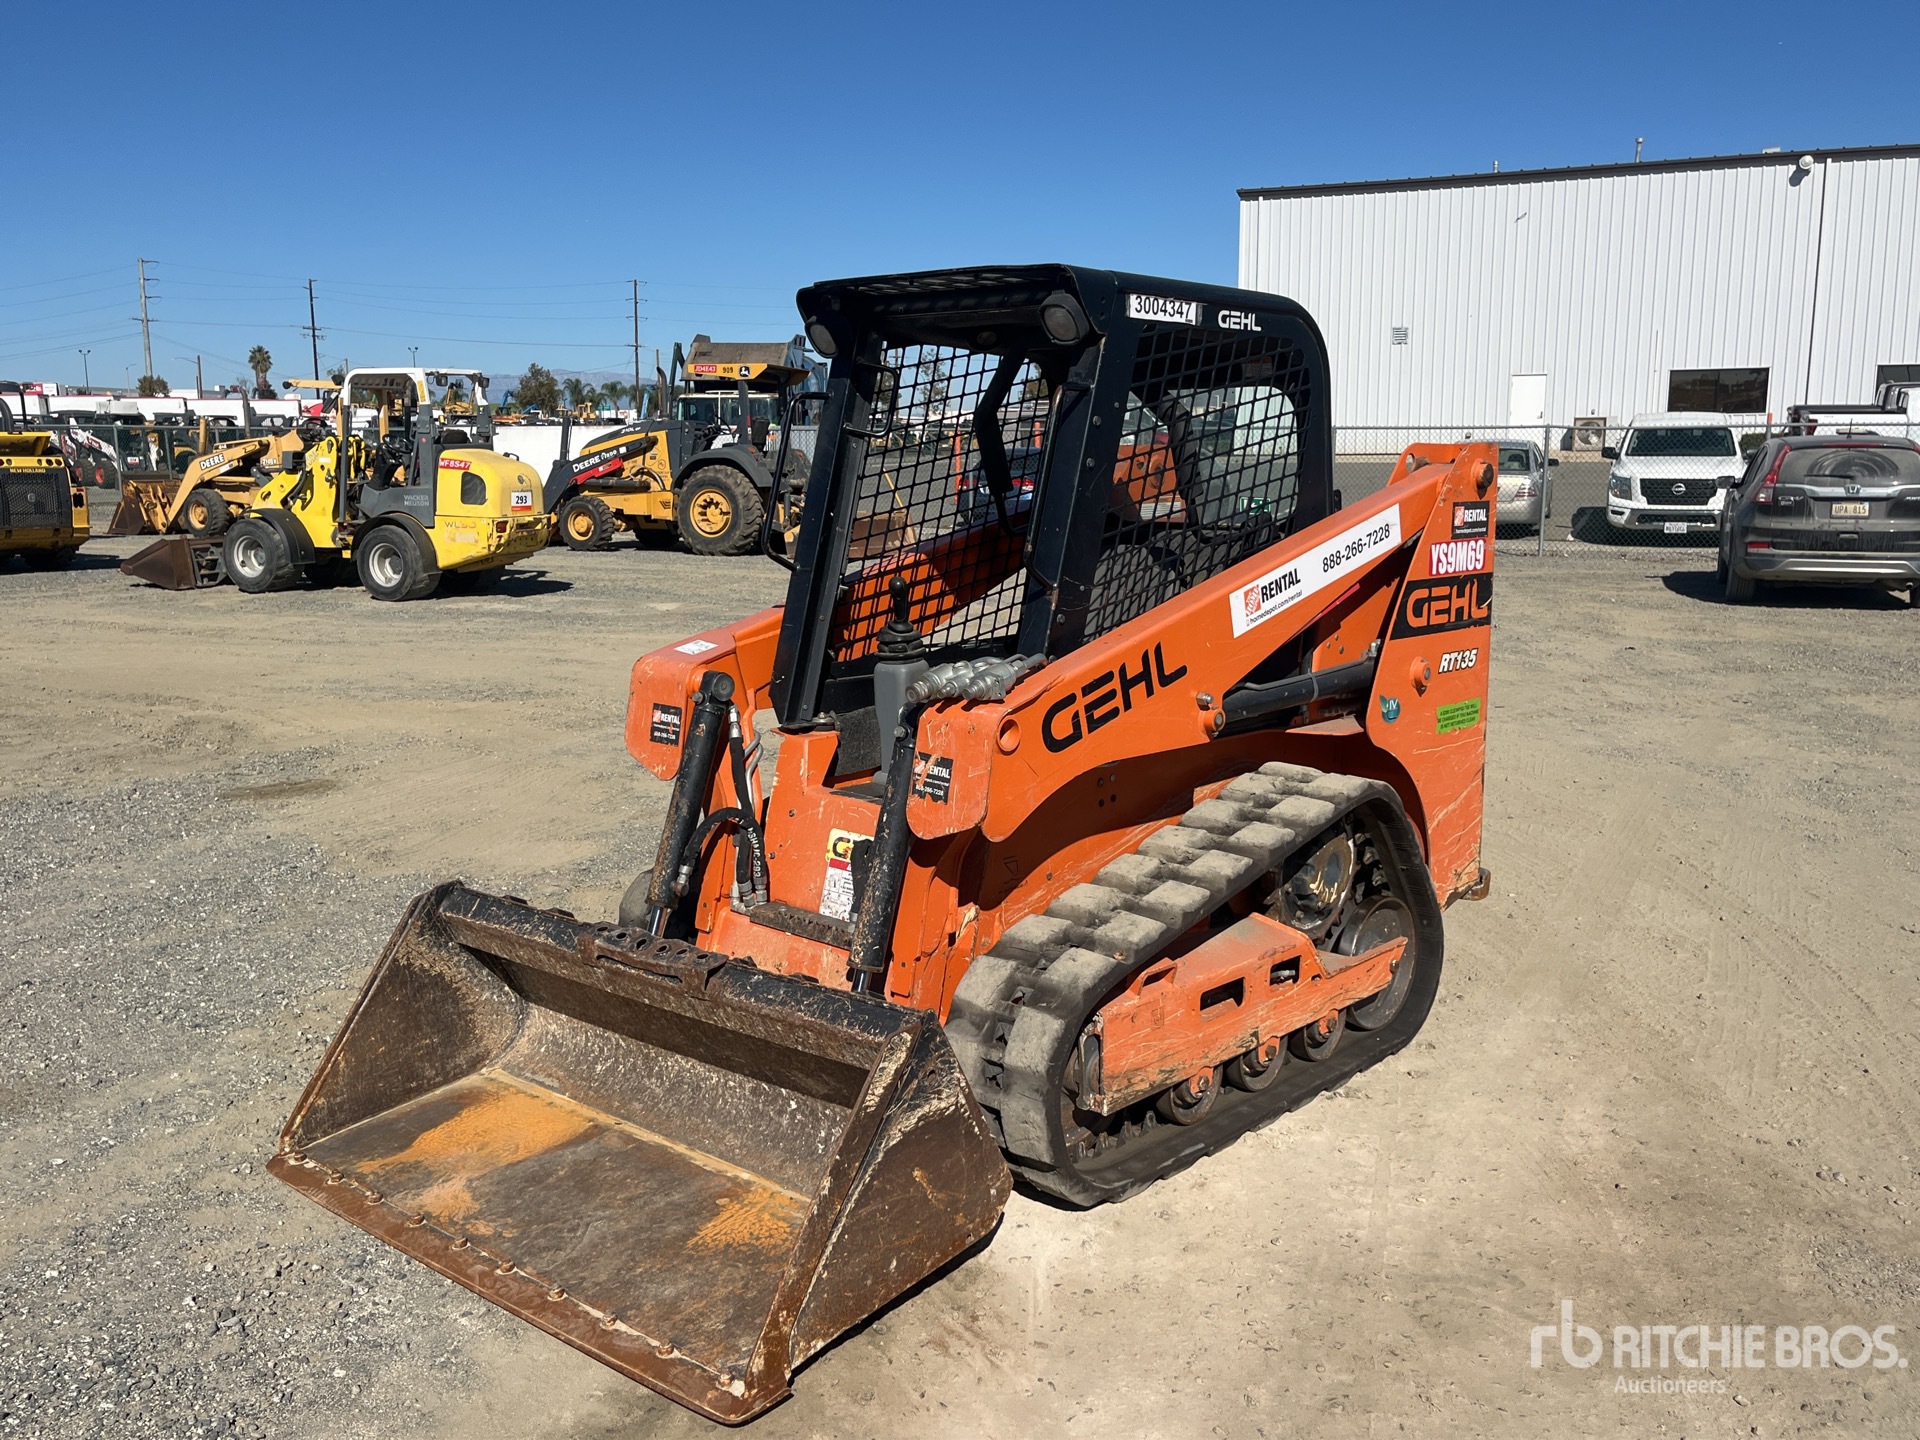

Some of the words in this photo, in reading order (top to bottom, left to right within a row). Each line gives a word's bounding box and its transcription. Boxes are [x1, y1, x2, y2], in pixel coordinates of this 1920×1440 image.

[1135, 296, 1192, 319] 3004347
[1218, 310, 1261, 331] GEHL
[200, 454, 224, 470] DEERE
[572, 455, 601, 473] DEERE
[515, 495, 528, 505] 293
[1464, 509, 1487, 522] RENTAL
[1322, 523, 1391, 573] 888-266-7228
[1431, 539, 1485, 575] YS9M69
[1260, 567, 1302, 604] RENTAL
[1406, 578, 1489, 628] GEHL
[1438, 648, 1479, 674] RT135
[1041, 641, 1188, 753] GEHL
[660, 713, 680, 724] RENTAL
[928, 765, 951, 779] ENTAL
